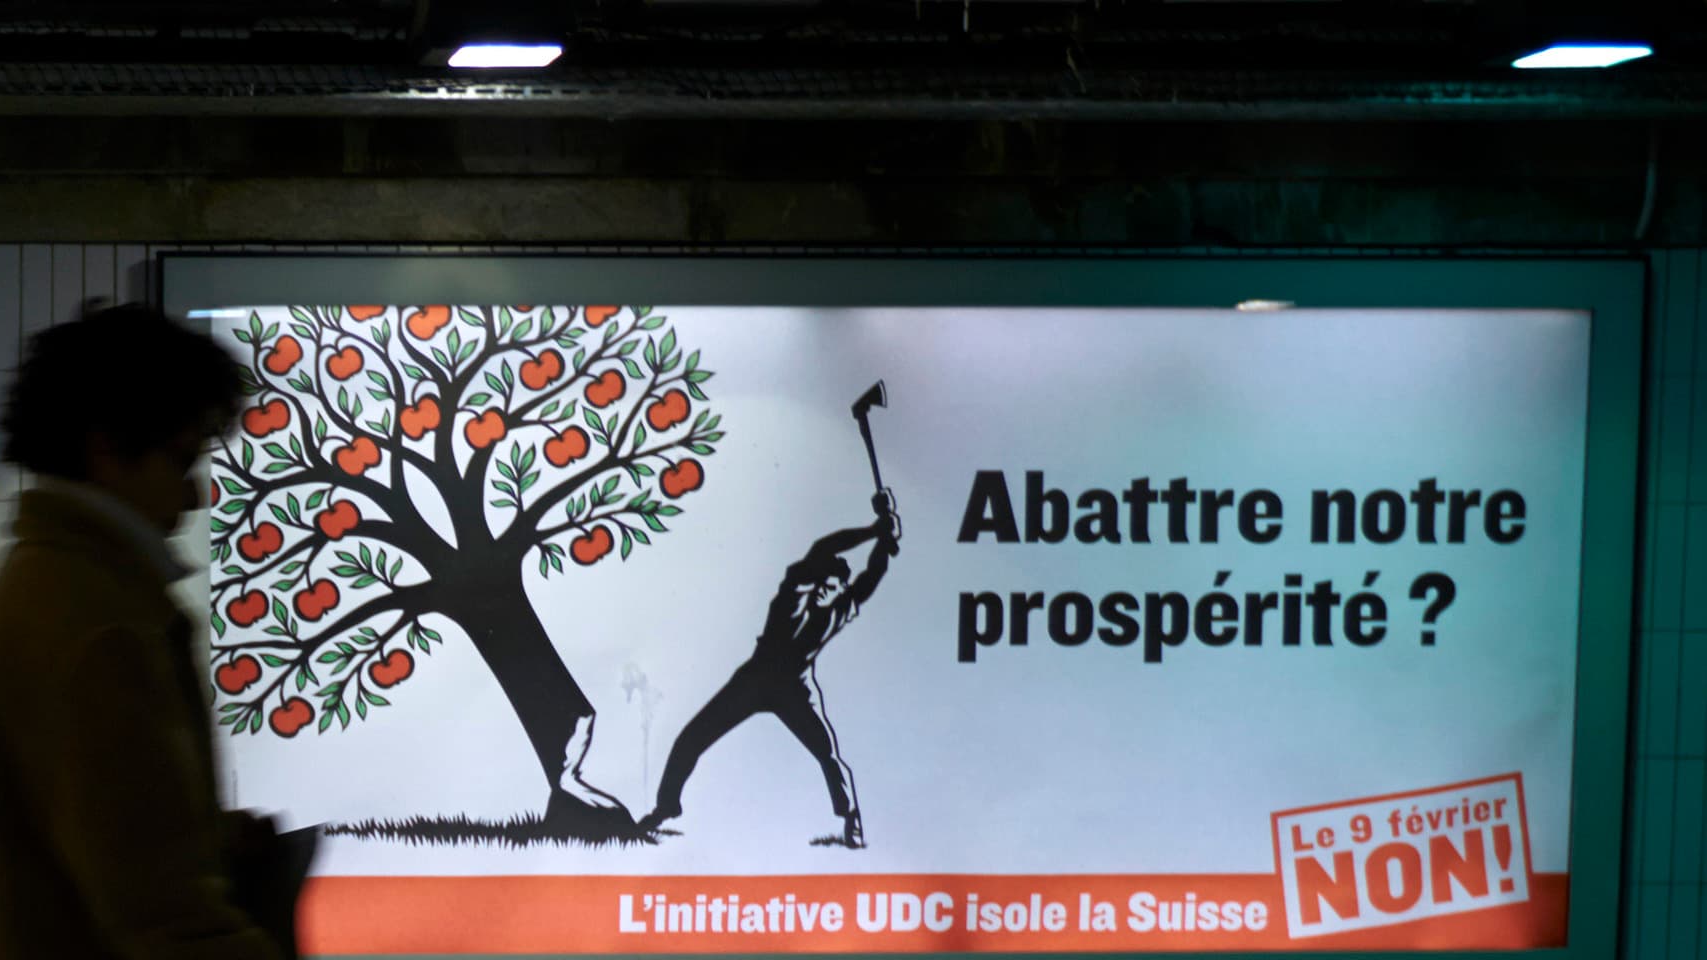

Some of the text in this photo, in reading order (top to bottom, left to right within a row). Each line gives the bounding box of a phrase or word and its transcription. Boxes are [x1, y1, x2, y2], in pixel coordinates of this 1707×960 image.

[956, 469, 1529, 547] Abattre notre
[957, 570, 1457, 664] prospérité ?
[1292, 797, 1507, 851] Le 9 février
[856, 892, 954, 933] UDC
[966, 893, 1067, 932] isole
[1078, 892, 1117, 932] la
[1127, 891, 1269, 933] Suisse
[1294, 823, 1515, 926] NON!
